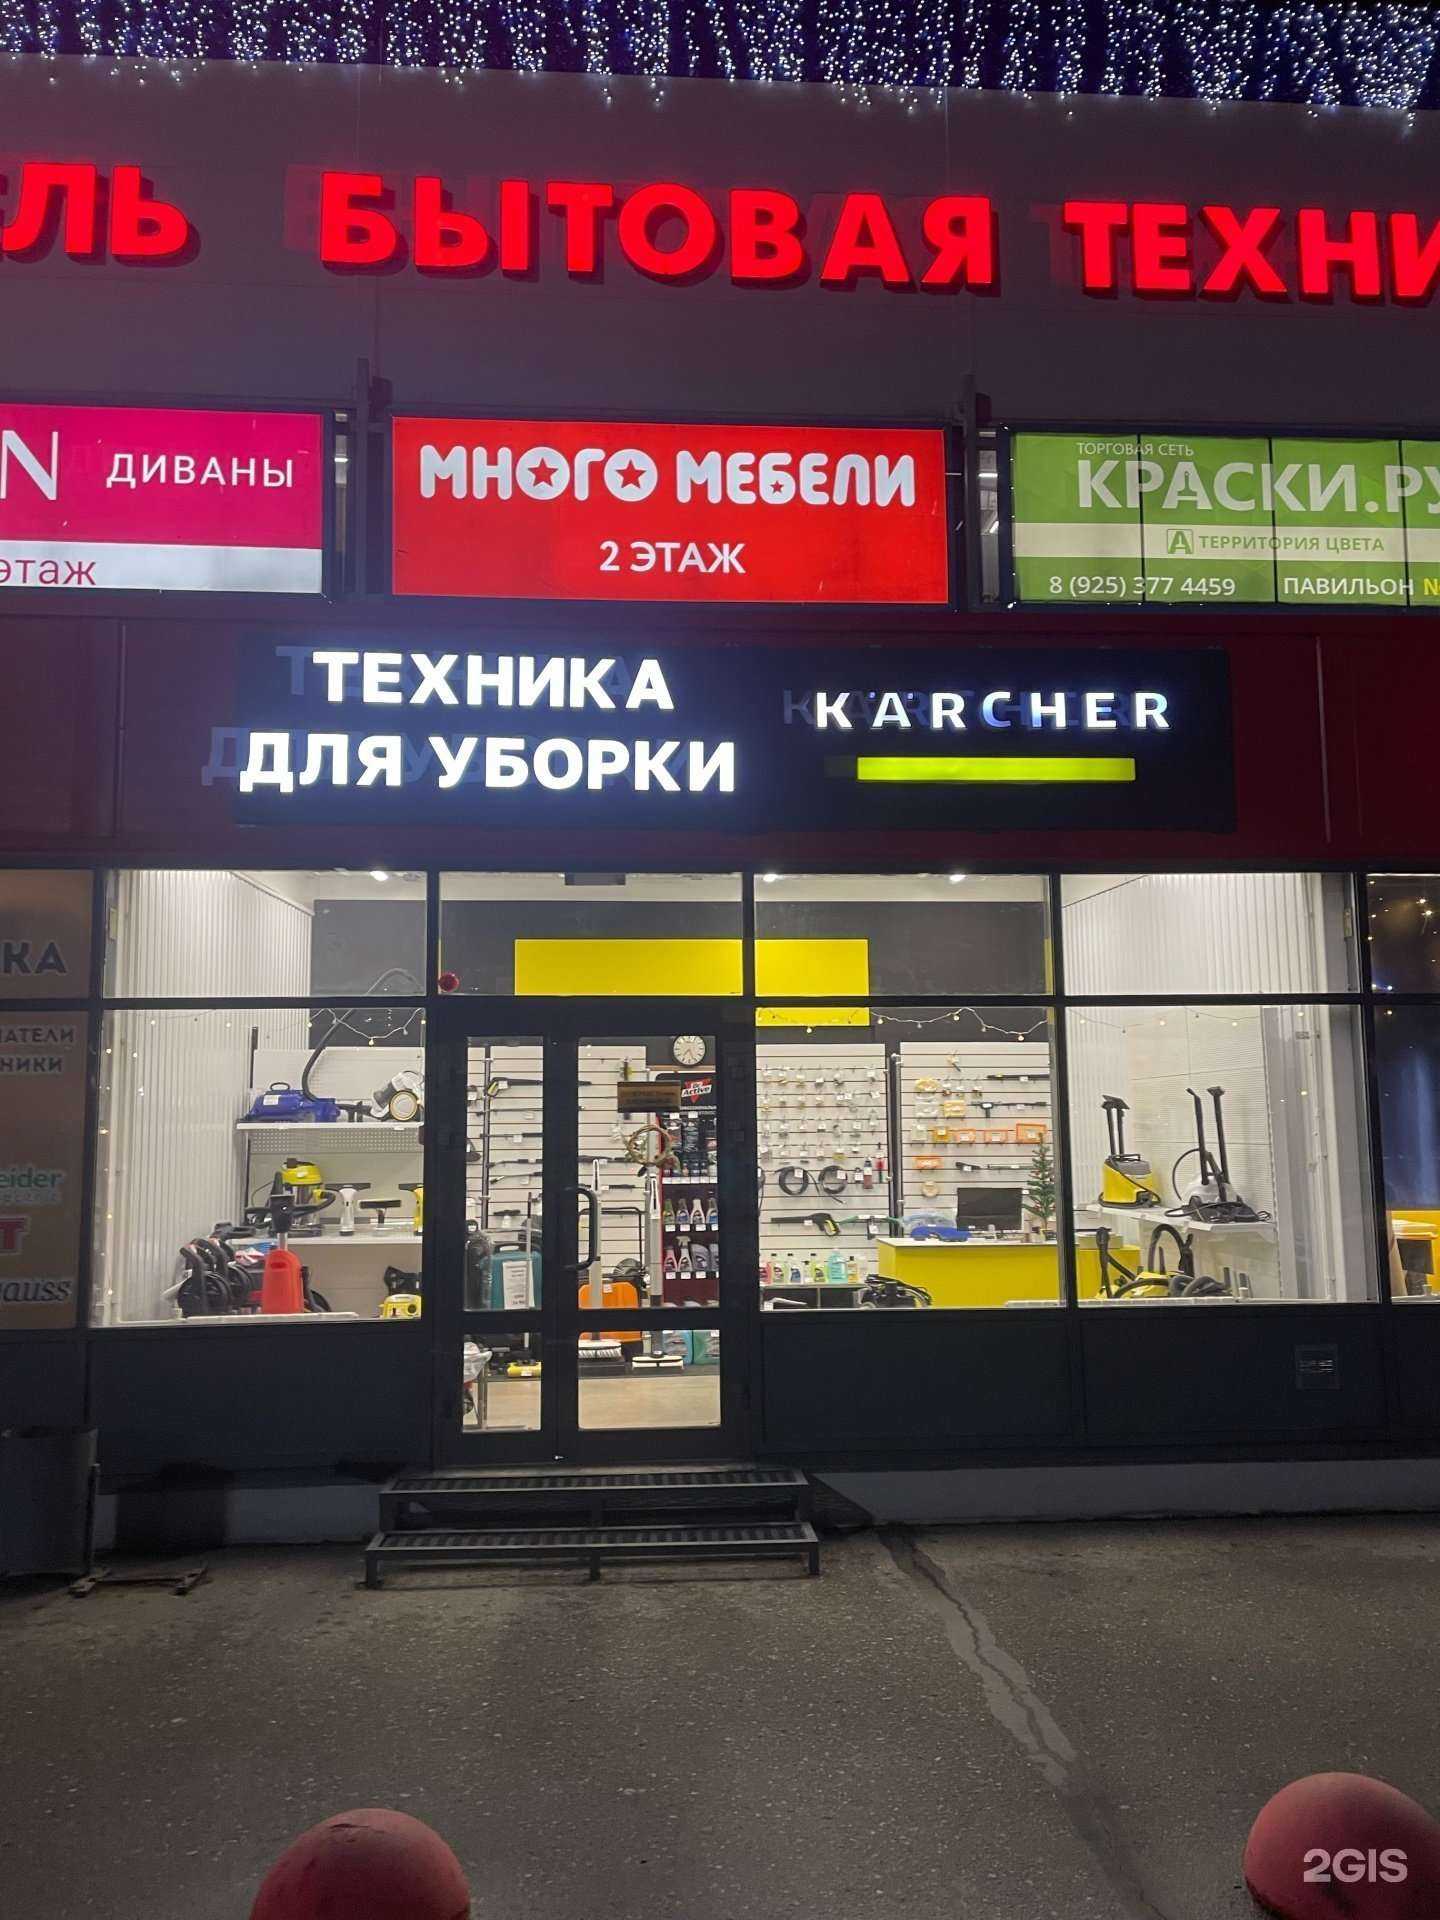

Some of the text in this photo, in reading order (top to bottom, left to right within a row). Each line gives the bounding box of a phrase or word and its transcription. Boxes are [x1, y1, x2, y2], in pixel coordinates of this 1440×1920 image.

[320, 172, 992, 284] БЫТОВАЯ
[1076, 442, 1194, 456] ТОРГОВАЯ СЕТЬ
[106, 453, 294, 489] ДИВАНЫ
[420, 444, 915, 507] МНОГО МЕБЕЛИ
[600, 540, 746, 573] 2 ЭТАЖ
[1199, 535, 1384, 553] ТЕРРИТОРИЯ ЦВЕТА
[1050, 576, 1236, 598] 8 (925) 377 4459
[1283, 577, 1414, 596] ПАВИЛЬОН
[313, 651, 674, 710] ТЕХНИКА
[239, 732, 736, 792] ДЛЯ УБОРКИ
[0, 1028, 74, 1043] АТЕЛИ
[0, 1279, 73, 1302] auss
